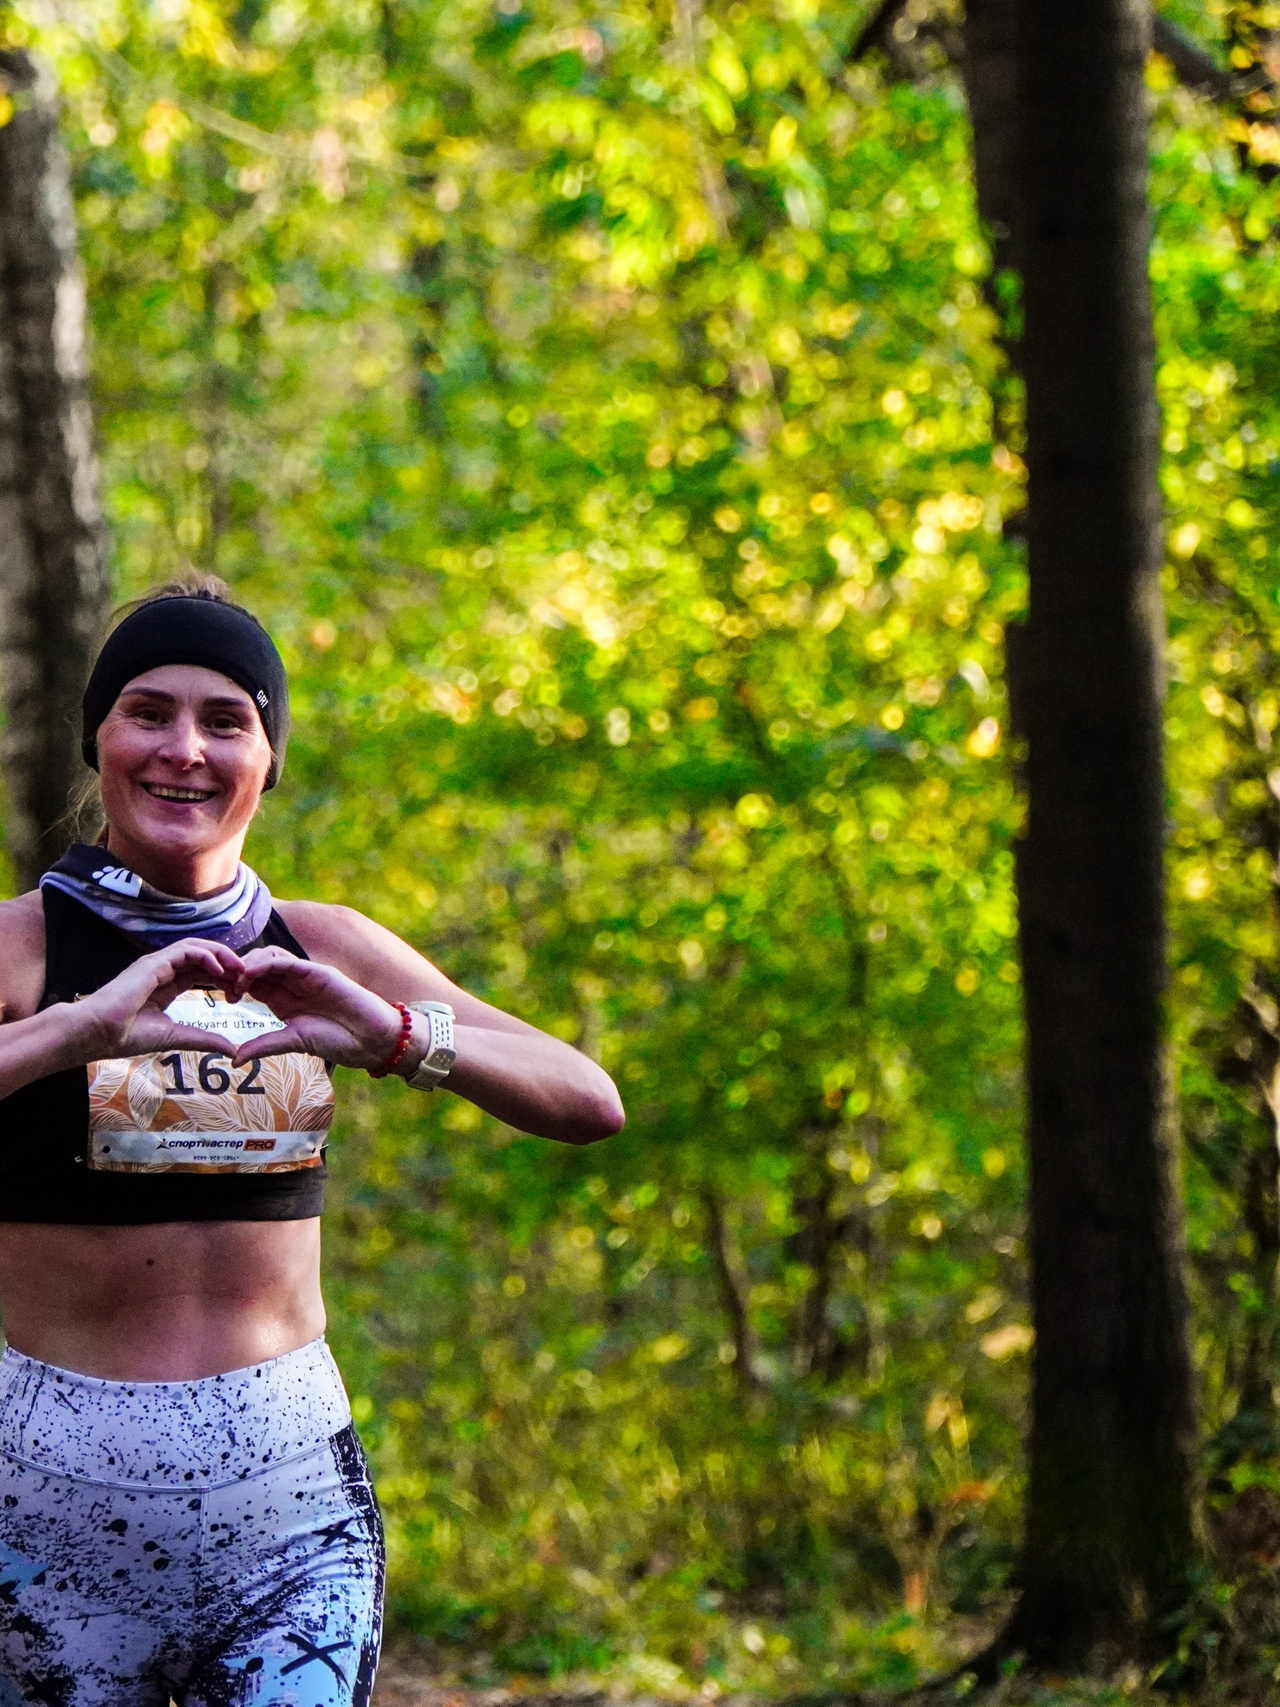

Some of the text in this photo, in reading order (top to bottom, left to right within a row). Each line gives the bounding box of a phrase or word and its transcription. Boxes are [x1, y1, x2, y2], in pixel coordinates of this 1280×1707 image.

[233, 1019, 265, 1029] Ultra
[270, 1020, 287, 1029] Mo
[159, 1053, 266, 1096] 162
[245, 1140, 274, 1151] PRO
